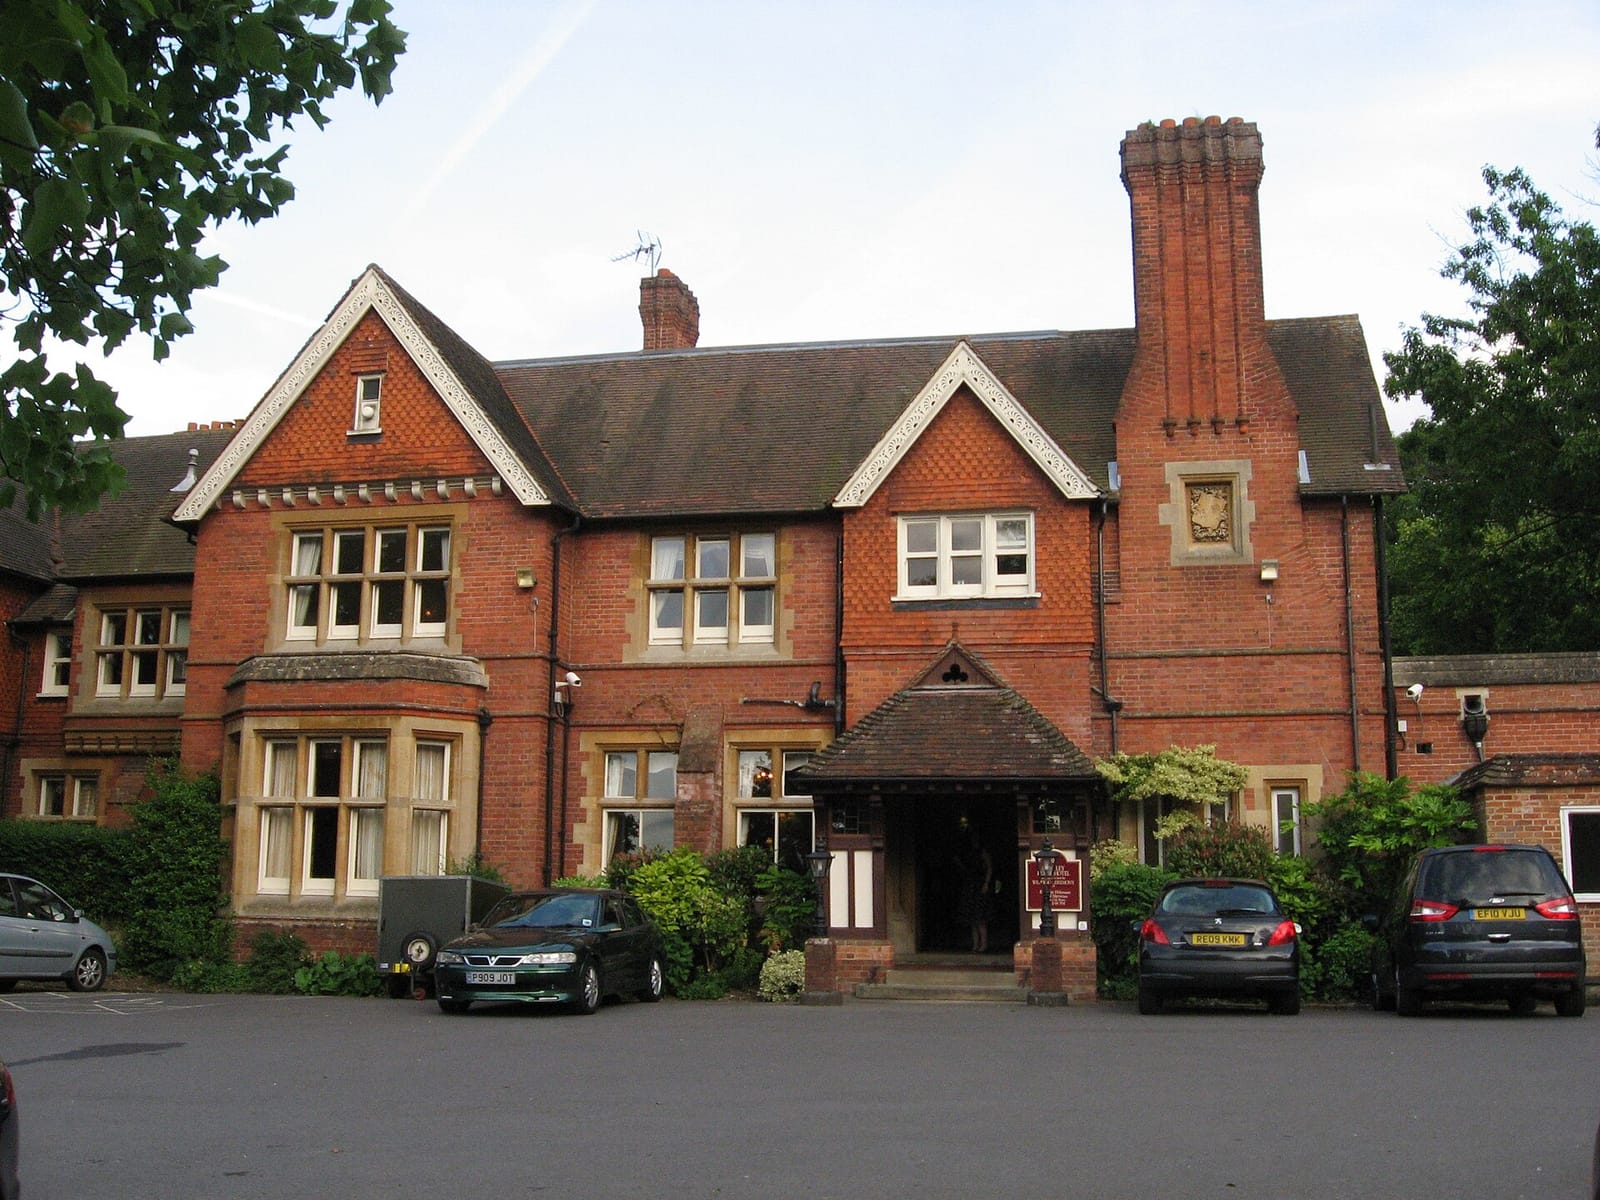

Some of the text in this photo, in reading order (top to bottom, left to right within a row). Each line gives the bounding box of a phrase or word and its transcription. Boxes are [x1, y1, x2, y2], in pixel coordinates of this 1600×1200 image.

[1477, 909, 1521, 918] EF10 VJU
[1196, 935, 1220, 944] RE09
[472, 973, 513, 983] P909 JOT
